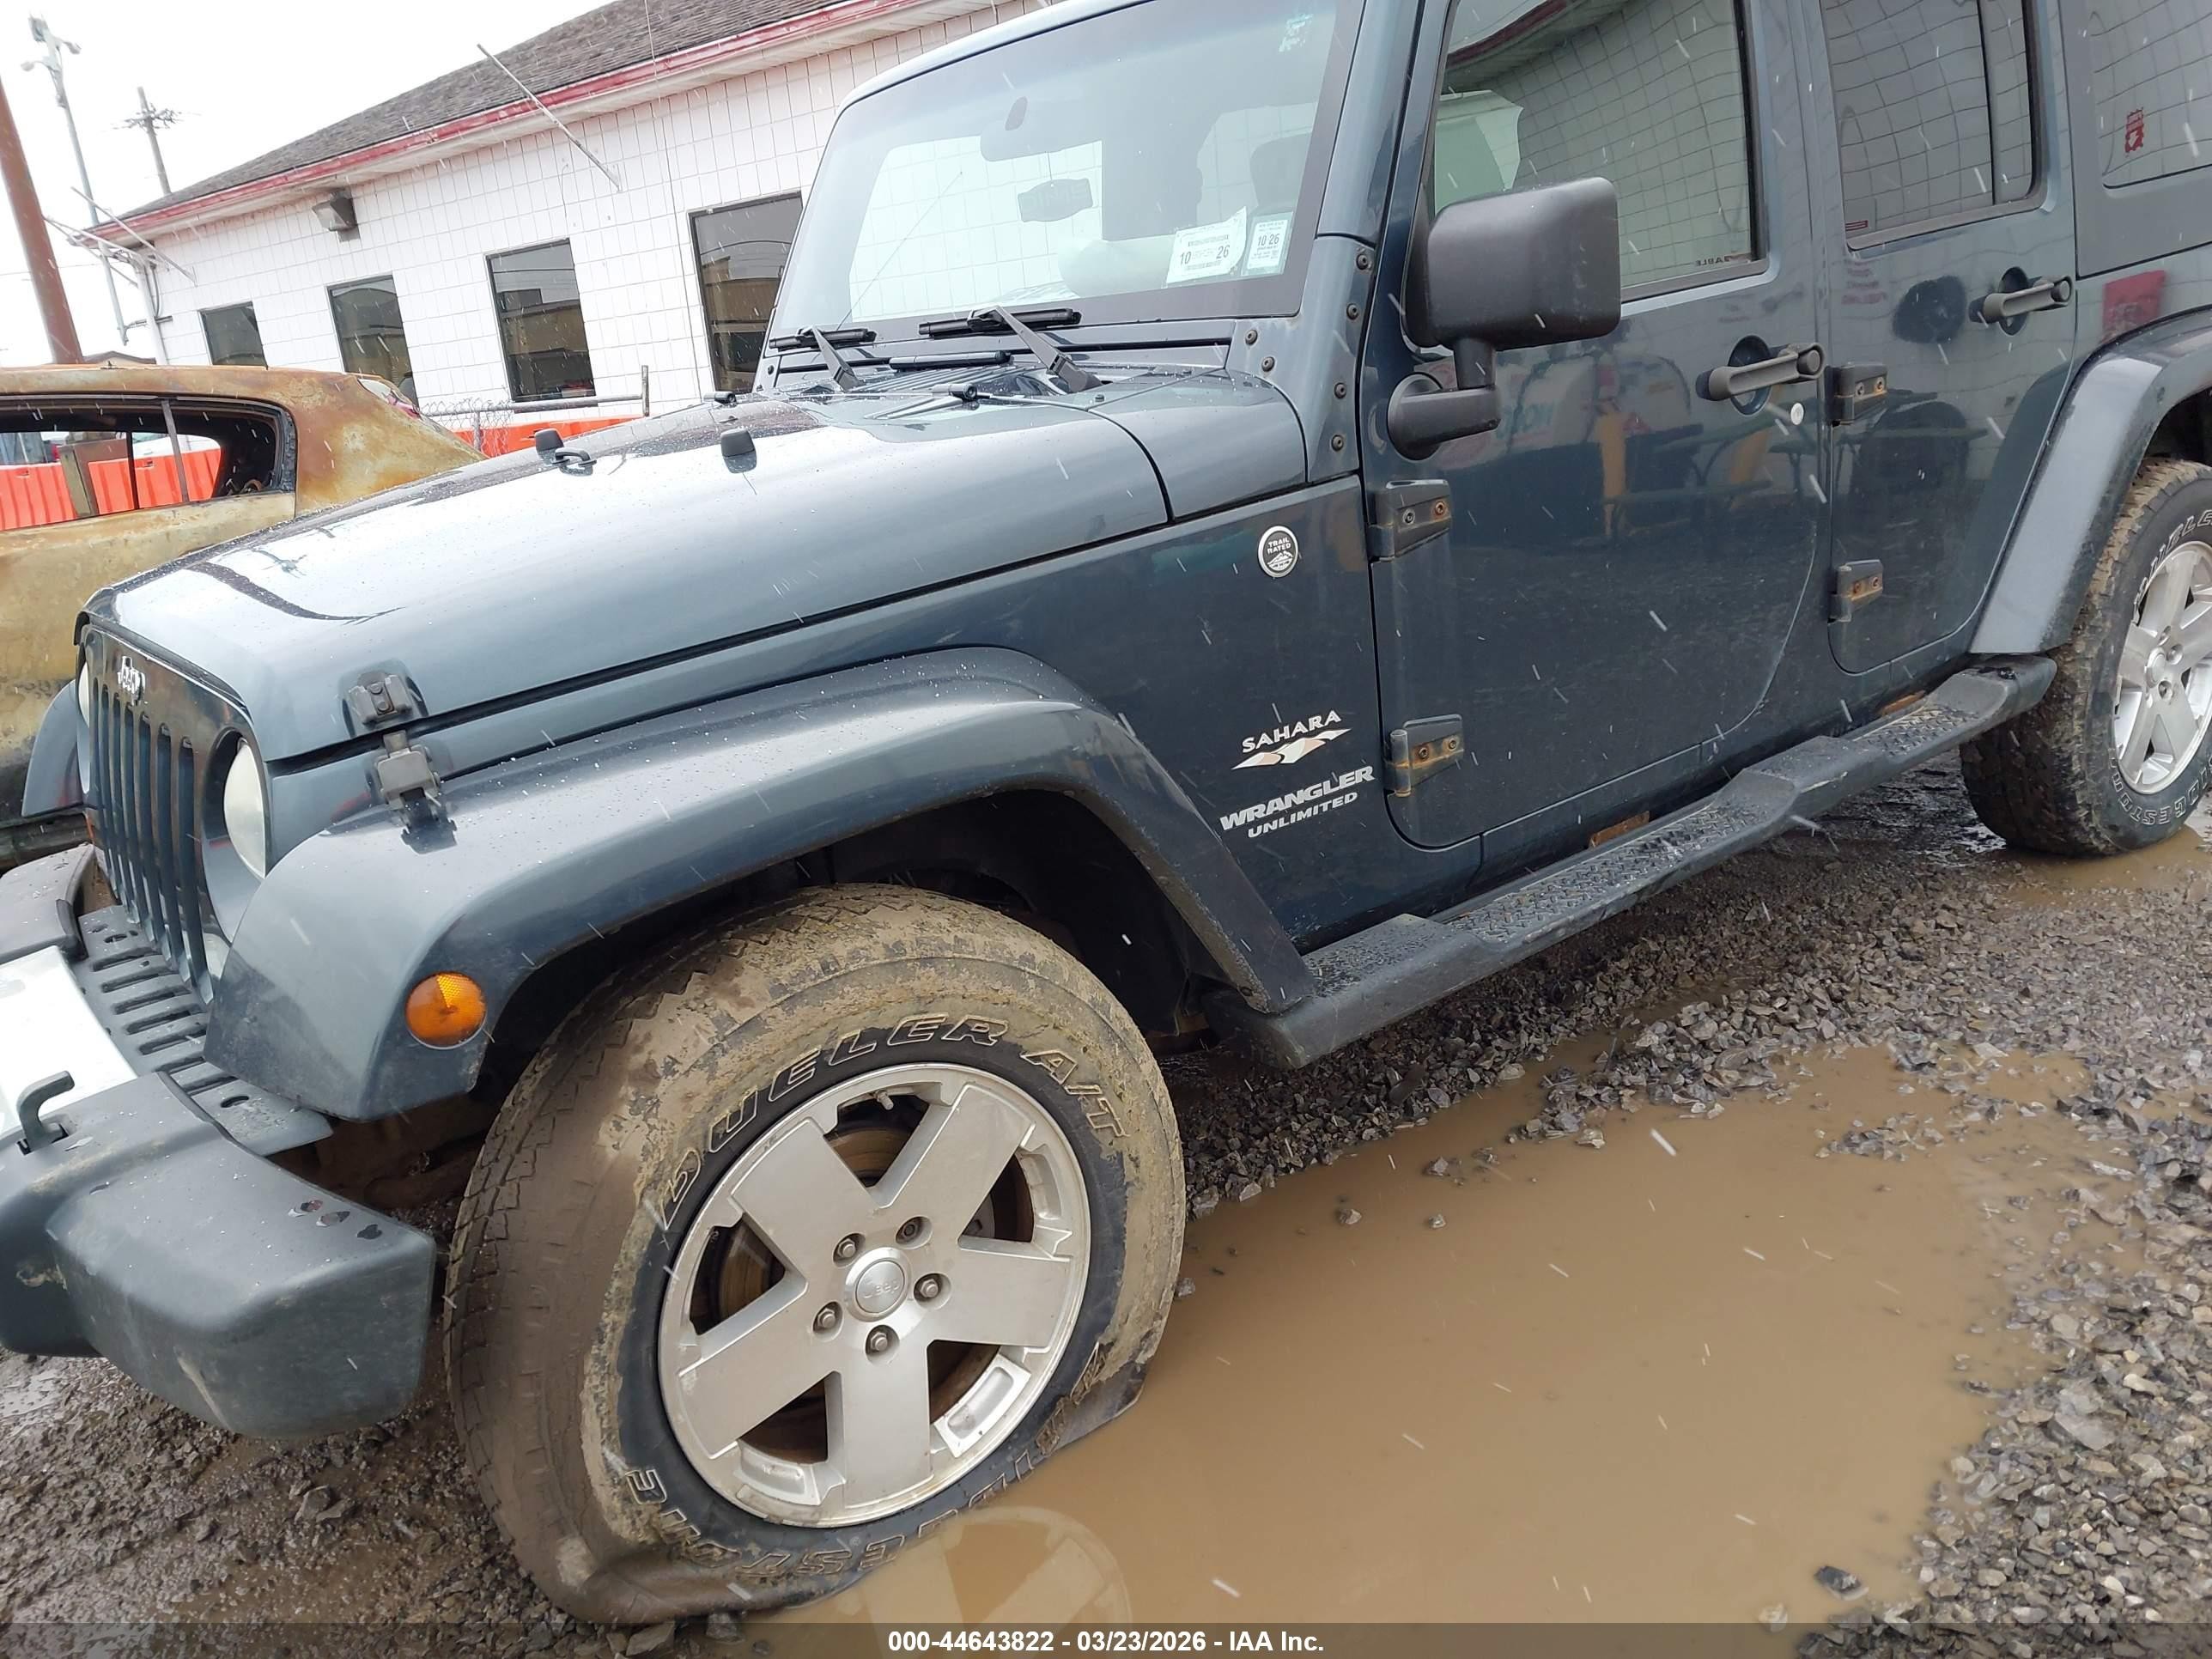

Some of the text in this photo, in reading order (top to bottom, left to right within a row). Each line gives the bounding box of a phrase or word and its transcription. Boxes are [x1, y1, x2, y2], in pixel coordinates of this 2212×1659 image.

[1180, 251, 1192, 266] 10
[1216, 245, 1231, 259] 26
[1267, 537, 1290, 548] TRAIL
[1267, 543, 1291, 555] RATED
[1242, 710, 1342, 753] SAHARA
[1219, 765, 1376, 830] WRANGLER
[1248, 792, 1358, 838] UNLIMITED
